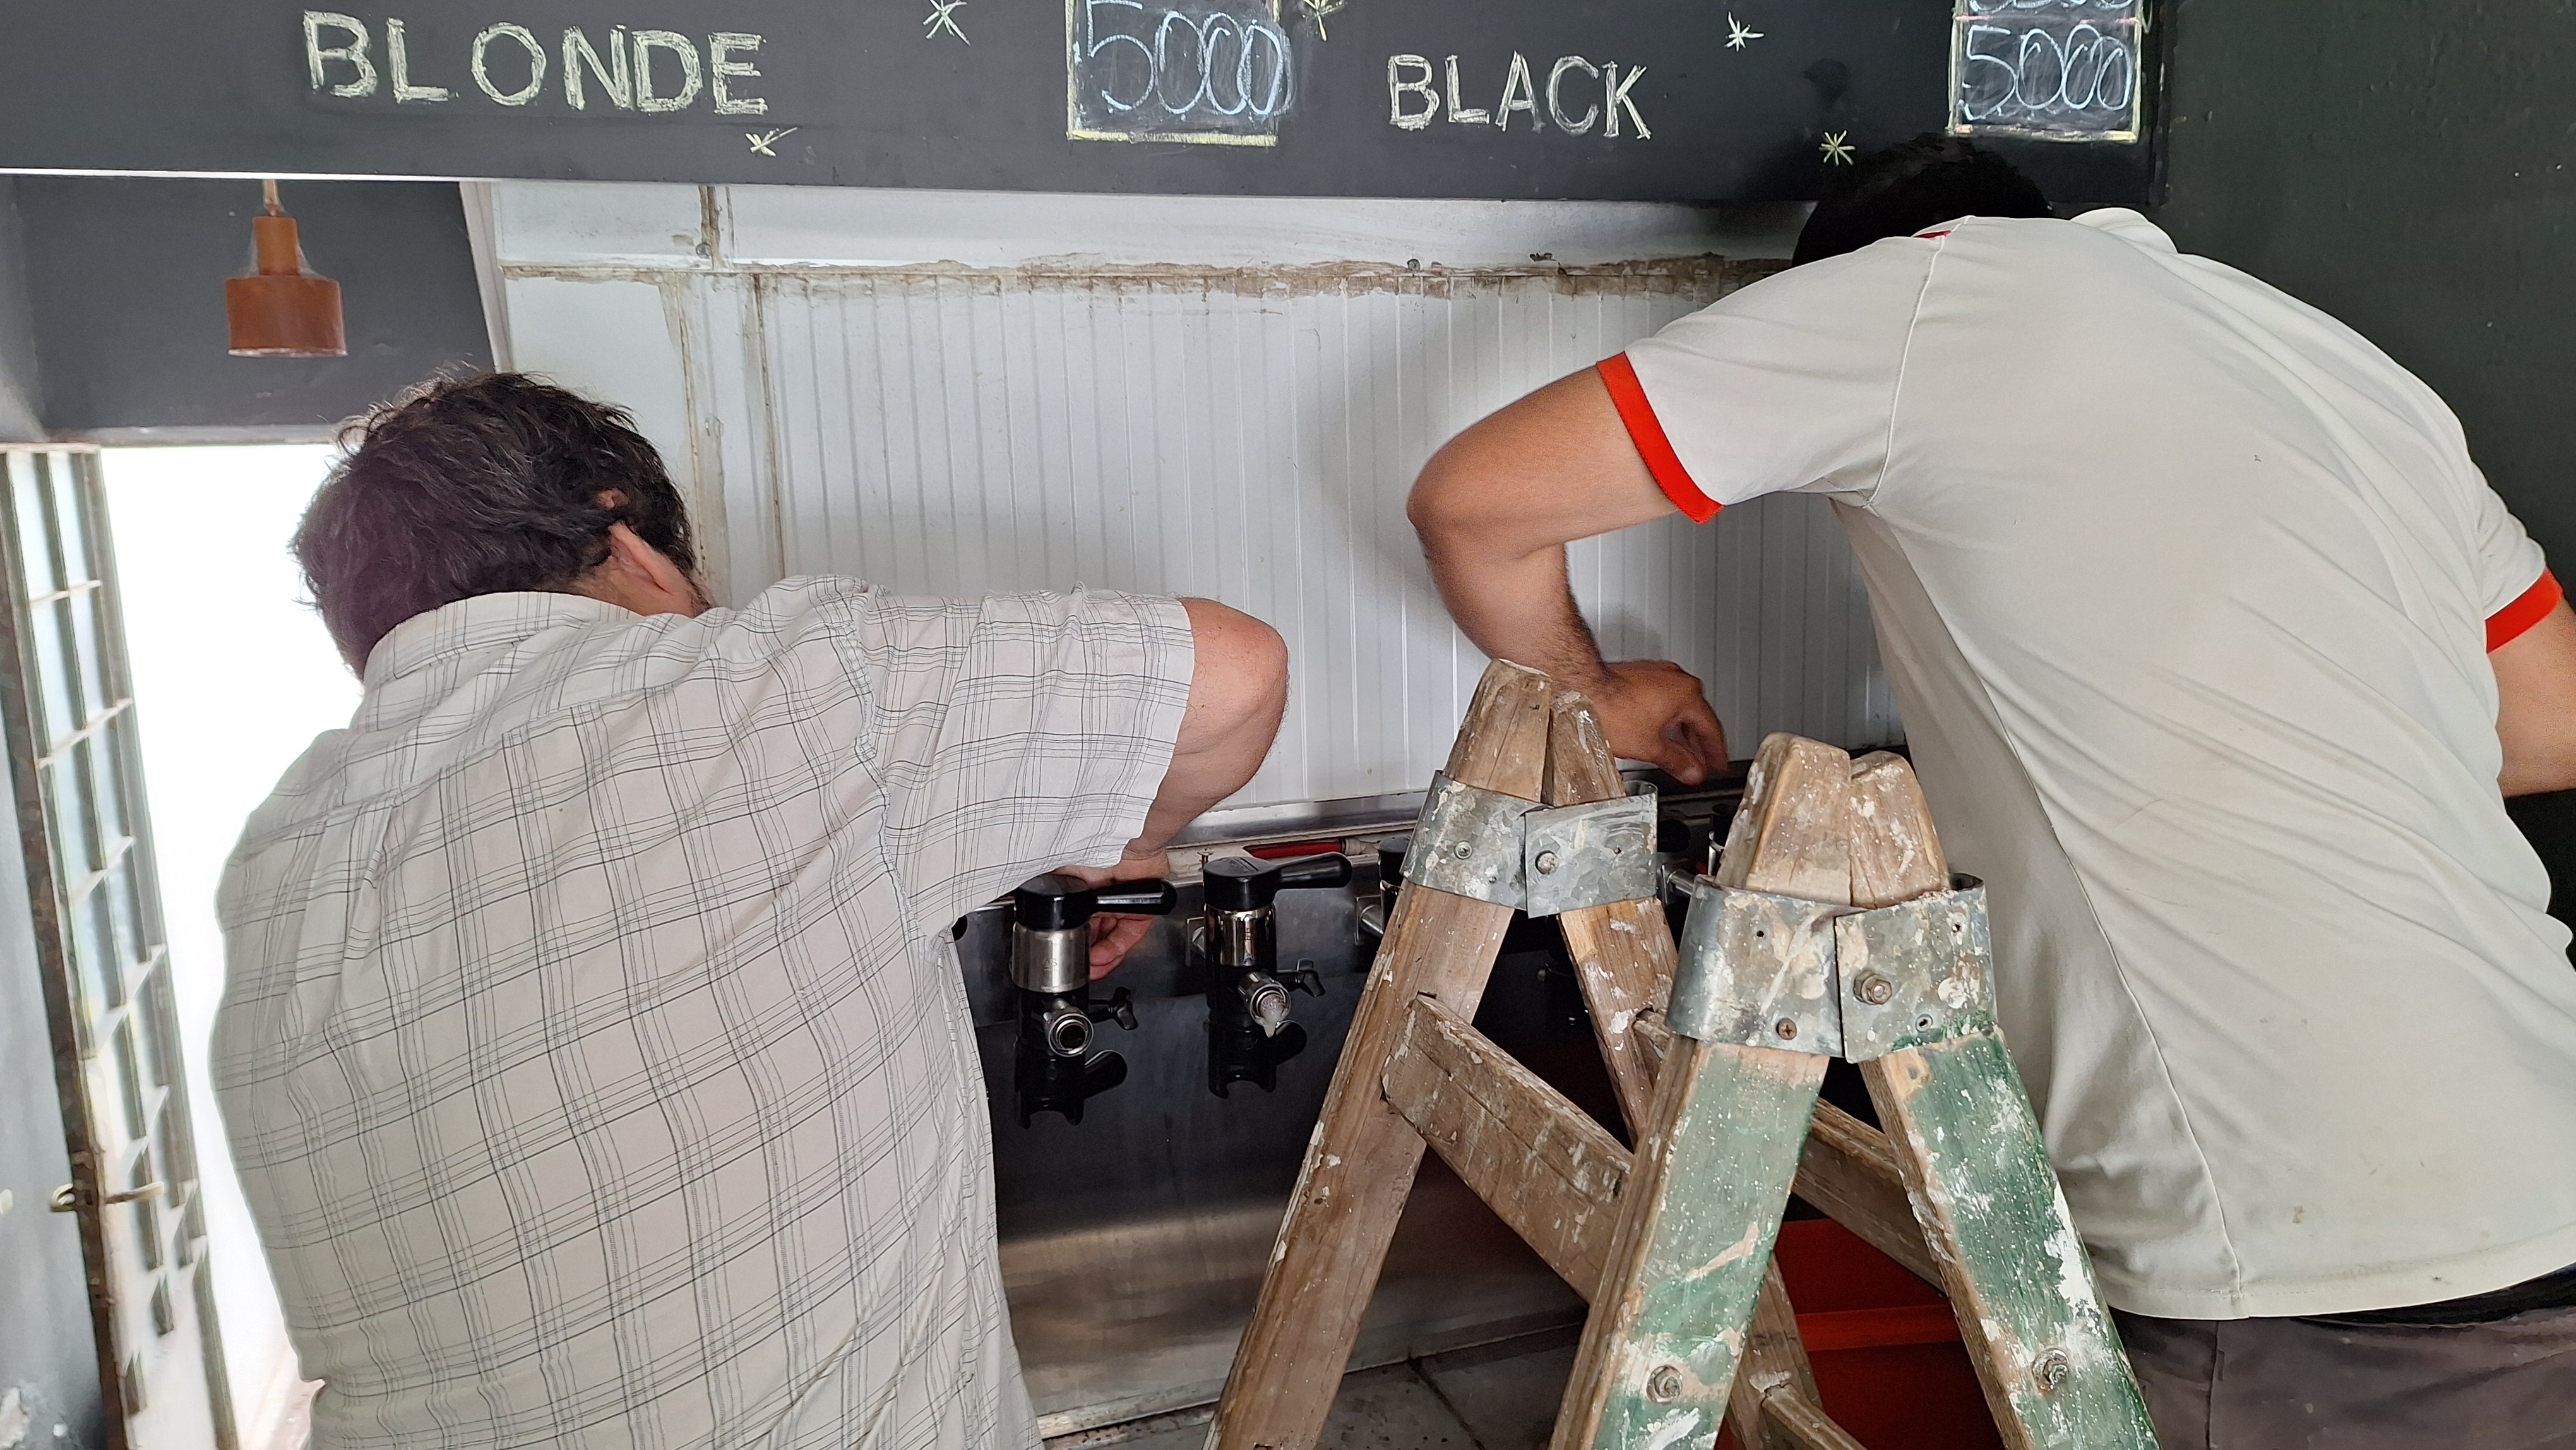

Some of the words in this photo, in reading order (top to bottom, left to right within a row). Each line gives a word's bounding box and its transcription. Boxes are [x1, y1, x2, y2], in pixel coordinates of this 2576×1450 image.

[304, 9, 768, 115] BLONDE
[1086, 0, 1293, 115] 5000
[1388, 51, 1652, 140] BLACK
[1959, 24, 2133, 121] 5000
